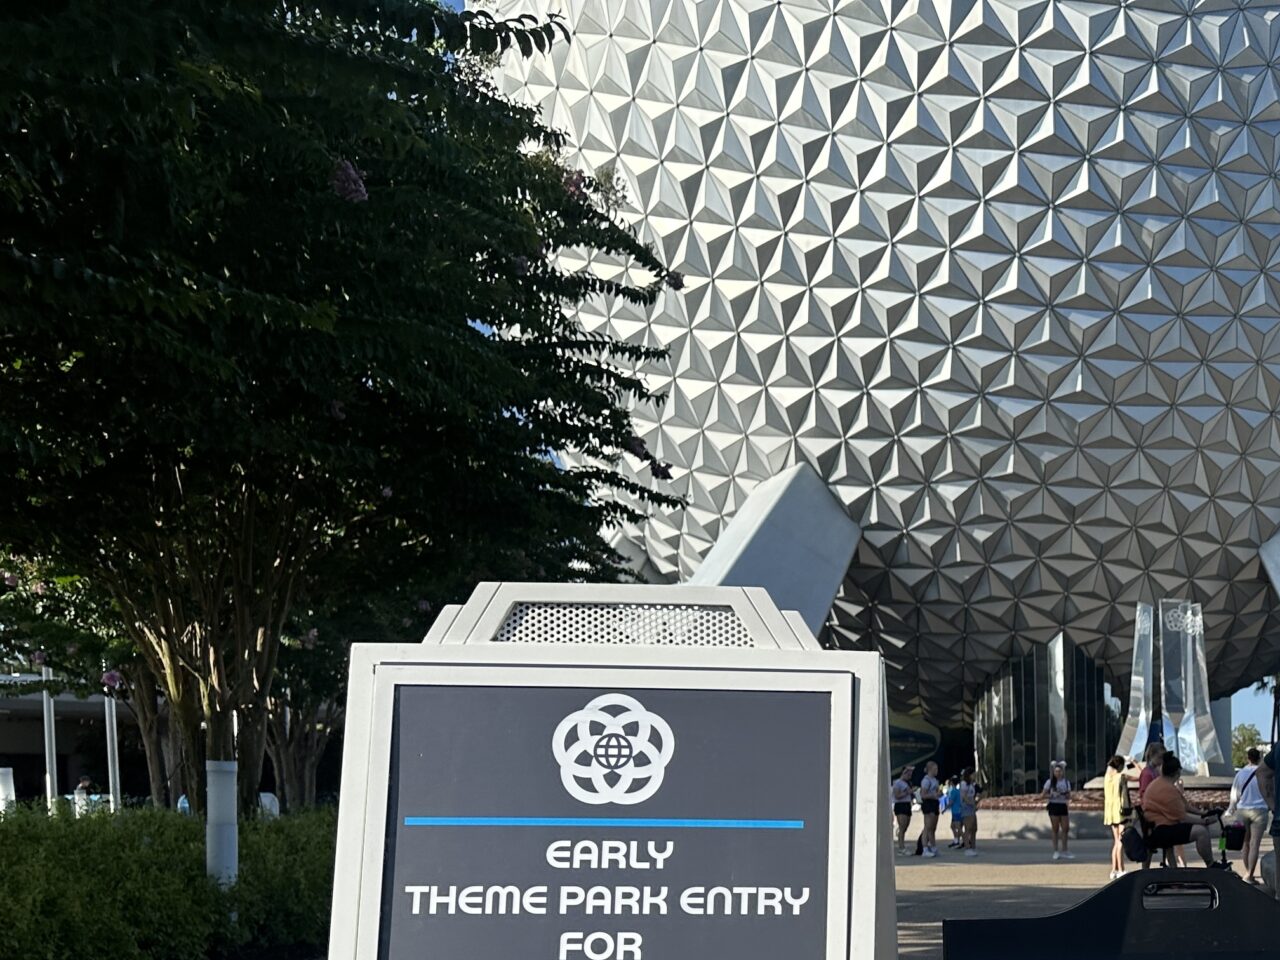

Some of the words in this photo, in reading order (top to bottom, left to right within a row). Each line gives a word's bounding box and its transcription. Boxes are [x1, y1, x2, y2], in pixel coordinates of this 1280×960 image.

[546, 839, 675, 870] EARLY
[405, 884, 548, 915] THEME
[559, 885, 669, 916] PARK
[680, 886, 811, 916] ENTRY
